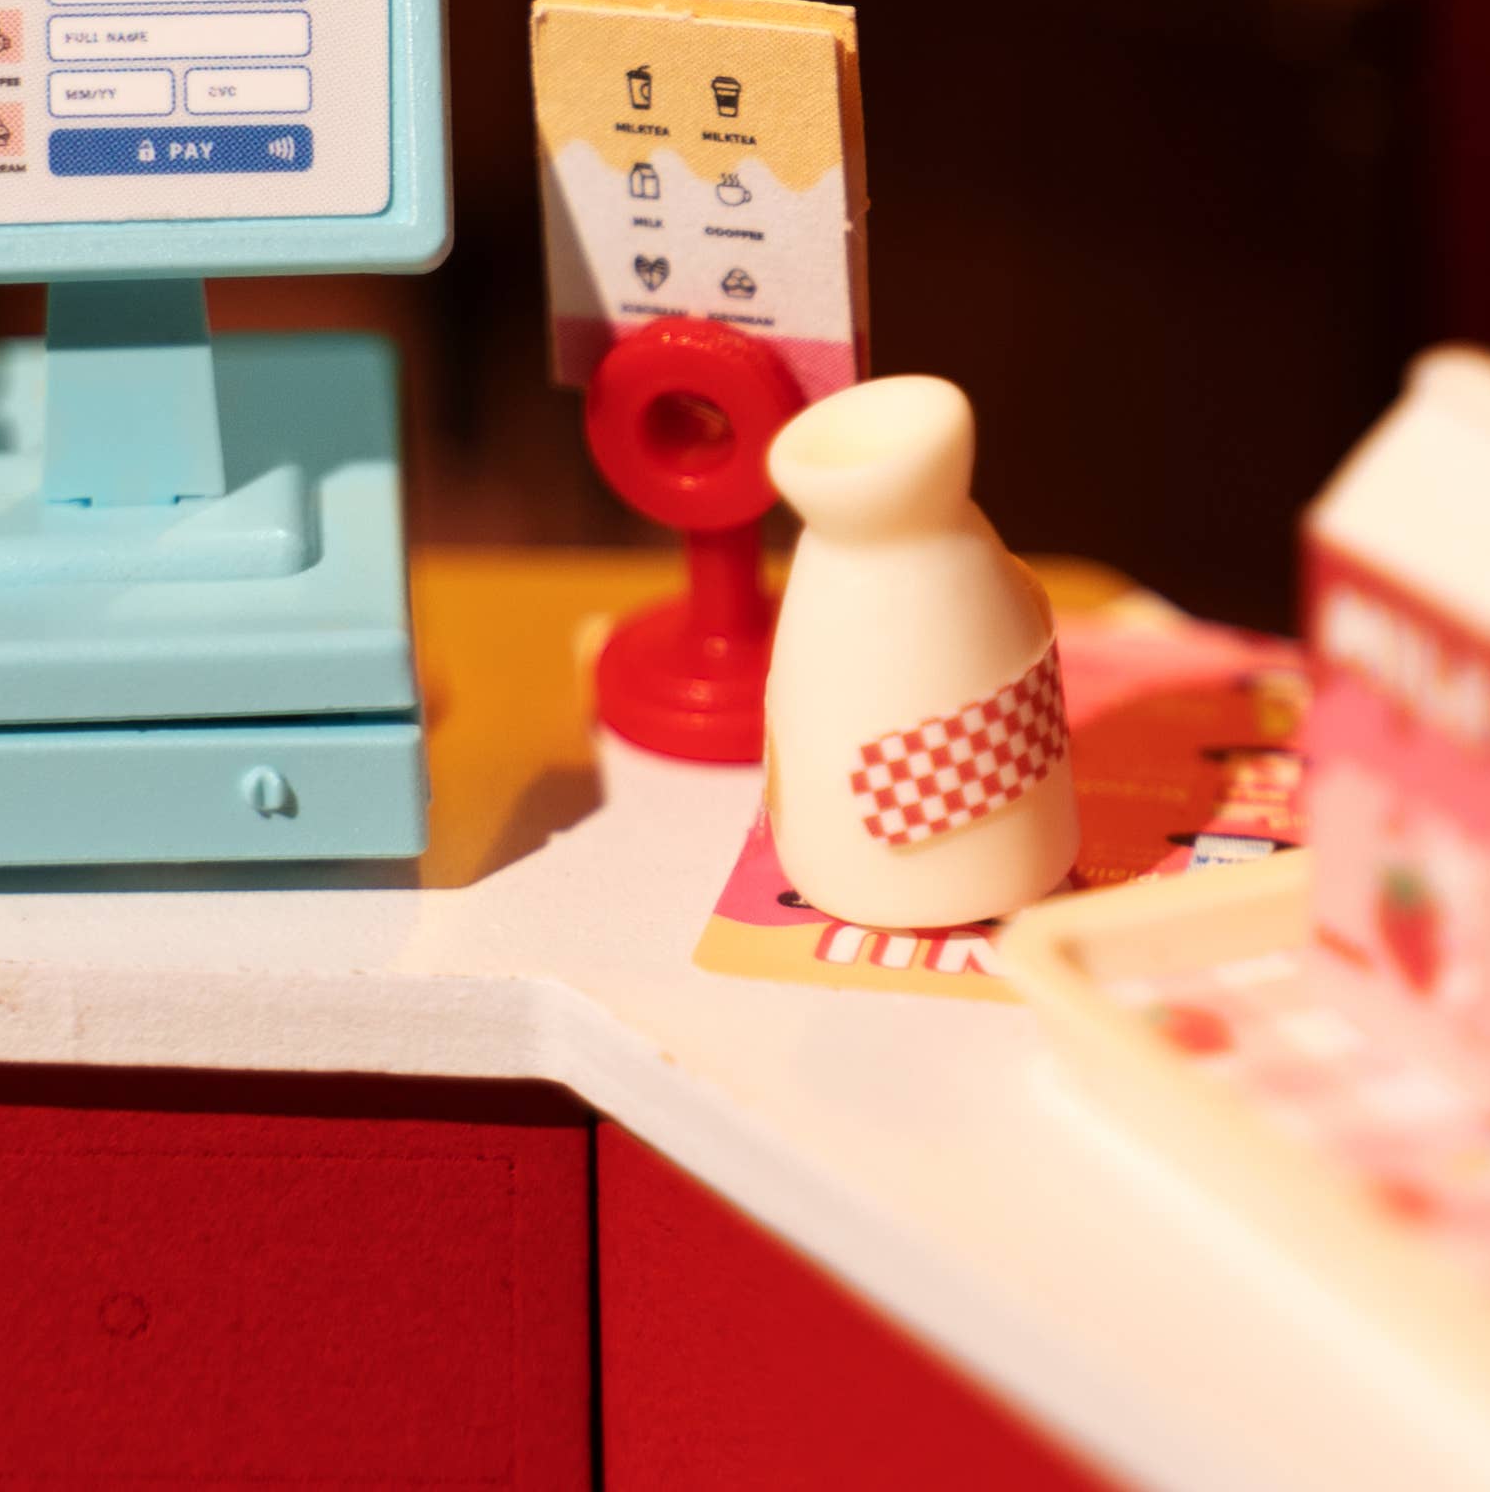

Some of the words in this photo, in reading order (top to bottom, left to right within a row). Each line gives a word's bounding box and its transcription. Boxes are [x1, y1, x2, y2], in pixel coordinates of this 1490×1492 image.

[64, 32, 99, 45] FULL
[106, 31, 149, 44] NAME
[64, 87, 117, 101] MM/YY
[614, 122, 670, 137] MILKTEA
[701, 131, 757, 146] MILKTEA
[169, 141, 214, 161] PAY
[632, 217, 663, 229] MILK
